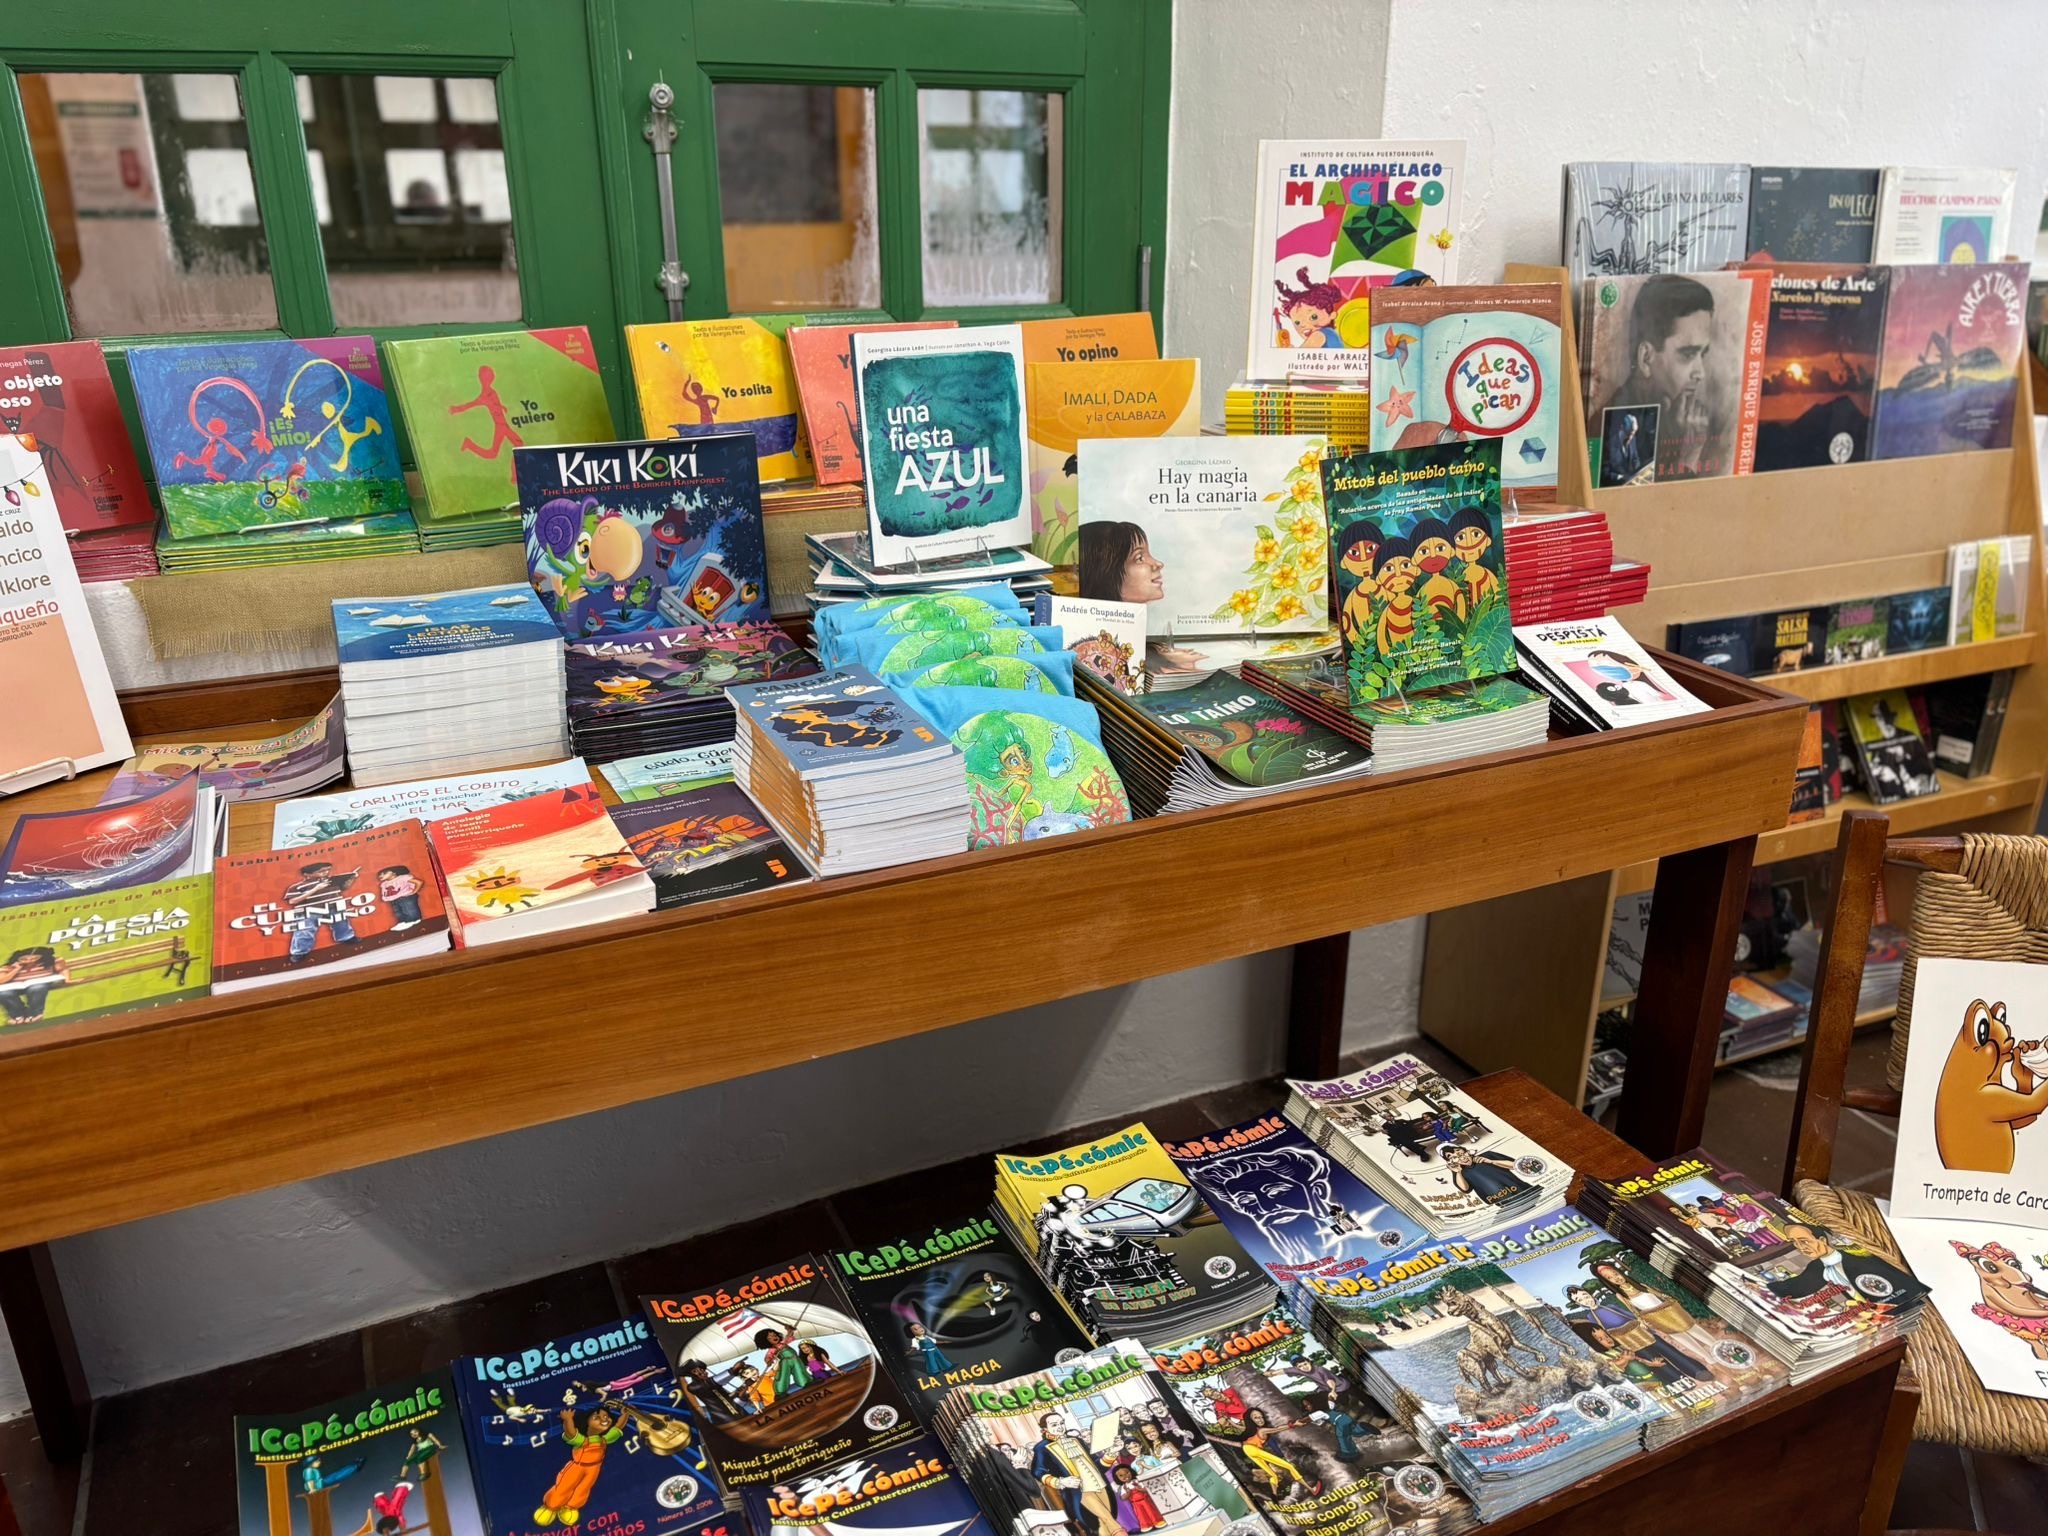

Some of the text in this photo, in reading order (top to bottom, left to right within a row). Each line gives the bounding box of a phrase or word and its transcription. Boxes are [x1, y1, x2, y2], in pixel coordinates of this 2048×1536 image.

[1290, 160, 1443, 178] EL ARCHIPIÉLAGO
[1285, 177, 1445, 207] MÁGICO
[1939, 195, 1975, 206] CAMPOS
[1821, 273, 1876, 291] de Arte
[1057, 343, 1119, 362] Yo opino
[1297, 353, 1369, 361] ISABEL ARRAIZ
[1457, 352, 1531, 389] Ideas
[4, 374, 63, 392] objeto
[722, 383, 773, 399] Yo solita
[1476, 377, 1511, 398] que
[1744, 361, 1761, 419] ENRIQUE
[0, 396, 32, 409] oso
[520, 399, 538, 411] Yo
[1064, 390, 1158, 406] IMALI, DADA
[1471, 393, 1522, 424] pican
[511, 411, 555, 428] quiero
[887, 404, 930, 425] una
[1086, 410, 1167, 424] y la CALABAZA
[889, 425, 954, 452] fiesta
[894, 446, 1005, 496] AZUL
[1158, 466, 1248, 490] Hay magia
[1333, 459, 1485, 492] Mitos del pueblo taíno
[562, 486, 598, 495] LEGEND
[673, 476, 727, 486] RAINFOREST
[1149, 486, 1257, 504] en la canaria
[4, 508, 22, 516] CRUZ
[0, 519, 34, 538] aldo
[0, 548, 43, 567] ncico
[0, 574, 52, 596] lklore
[1060, 604, 1135, 619] Andrés Chupadedos
[21, 620, 47, 632] CULTURA
[1536, 624, 1608, 643] DESPISTÁ
[1775, 616, 1809, 633] SALSA
[754, 671, 849, 694] PANGEA
[1159, 694, 1258, 726] LO TAÍNO
[350, 779, 521, 810] CARLITOS EL COBITO
[389, 791, 483, 810] quiere escuchar
[409, 800, 468, 815] EL MAR
[444, 825, 481, 835] infantil
[459, 818, 490, 829] teatro
[230, 827, 408, 867] Isabel Freire de Matos
[1, 883, 200, 922] Isabel Freire de Matos
[230, 892, 377, 929] CUENTO
[253, 902, 283, 914] EL
[49, 906, 190, 943] POESÍA
[71, 914, 104, 927] LA
[282, 921, 308, 933] EL
[70, 935, 121, 951] Y EL
[1003, 1132, 1148, 1176] ICePé.cómic
[1923, 1183, 2011, 1206] Trompeta de
[836, 1217, 1000, 1276] ICePé.cómic
[858, 1271, 895, 1282] Instituto
[905, 1258, 937, 1271] Cultura
[937, 1239, 995, 1263] Puertorriqueña
[650, 1263, 816, 1319] ICePé.cómic
[1123, 1279, 1177, 1299] TREN
[667, 1279, 812, 1324] Instituto de Cultura Puertorriqueña
[474, 1320, 649, 1382] ICePé.comic
[1155, 1320, 1295, 1374] CePé.cómic
[1207, 1334, 1305, 1375] Cultura Puertorriqueña
[502, 1344, 643, 1389] Instituto de Cultura Puertorriqueña
[917, 1358, 1002, 1391] LA MAGIA
[968, 1352, 1143, 1411] ICePé.cómic
[1033, 1397, 1072, 1411] Cultura
[1072, 1368, 1146, 1400] Puertorriqueña
[1663, 1376, 1696, 1397] CAFÉ
[755, 1388, 834, 1427] LA AURORA
[248, 1386, 442, 1453] ICePé.cómic
[1517, 1414, 1560, 1440] playas
[255, 1409, 439, 1462] Instituto de Cultura Puertorriqueña
[868, 1429, 890, 1443] Número
[1493, 1430, 1570, 1464] monumentos
[721, 1438, 819, 1474] Miguel Enríquez,
[728, 1438, 853, 1485] corsario puertorriqueño
[766, 1455, 943, 1518] ICePé.cómic
[1264, 1477, 1375, 1513] Nuestra cultura,
[771, 1472, 950, 1527] Instituto de Cultura Puertorriqueña
[1316, 1489, 1380, 1524] como un
[587, 1511, 620, 1533] con
[657, 1499, 714, 1524] Número 2006
